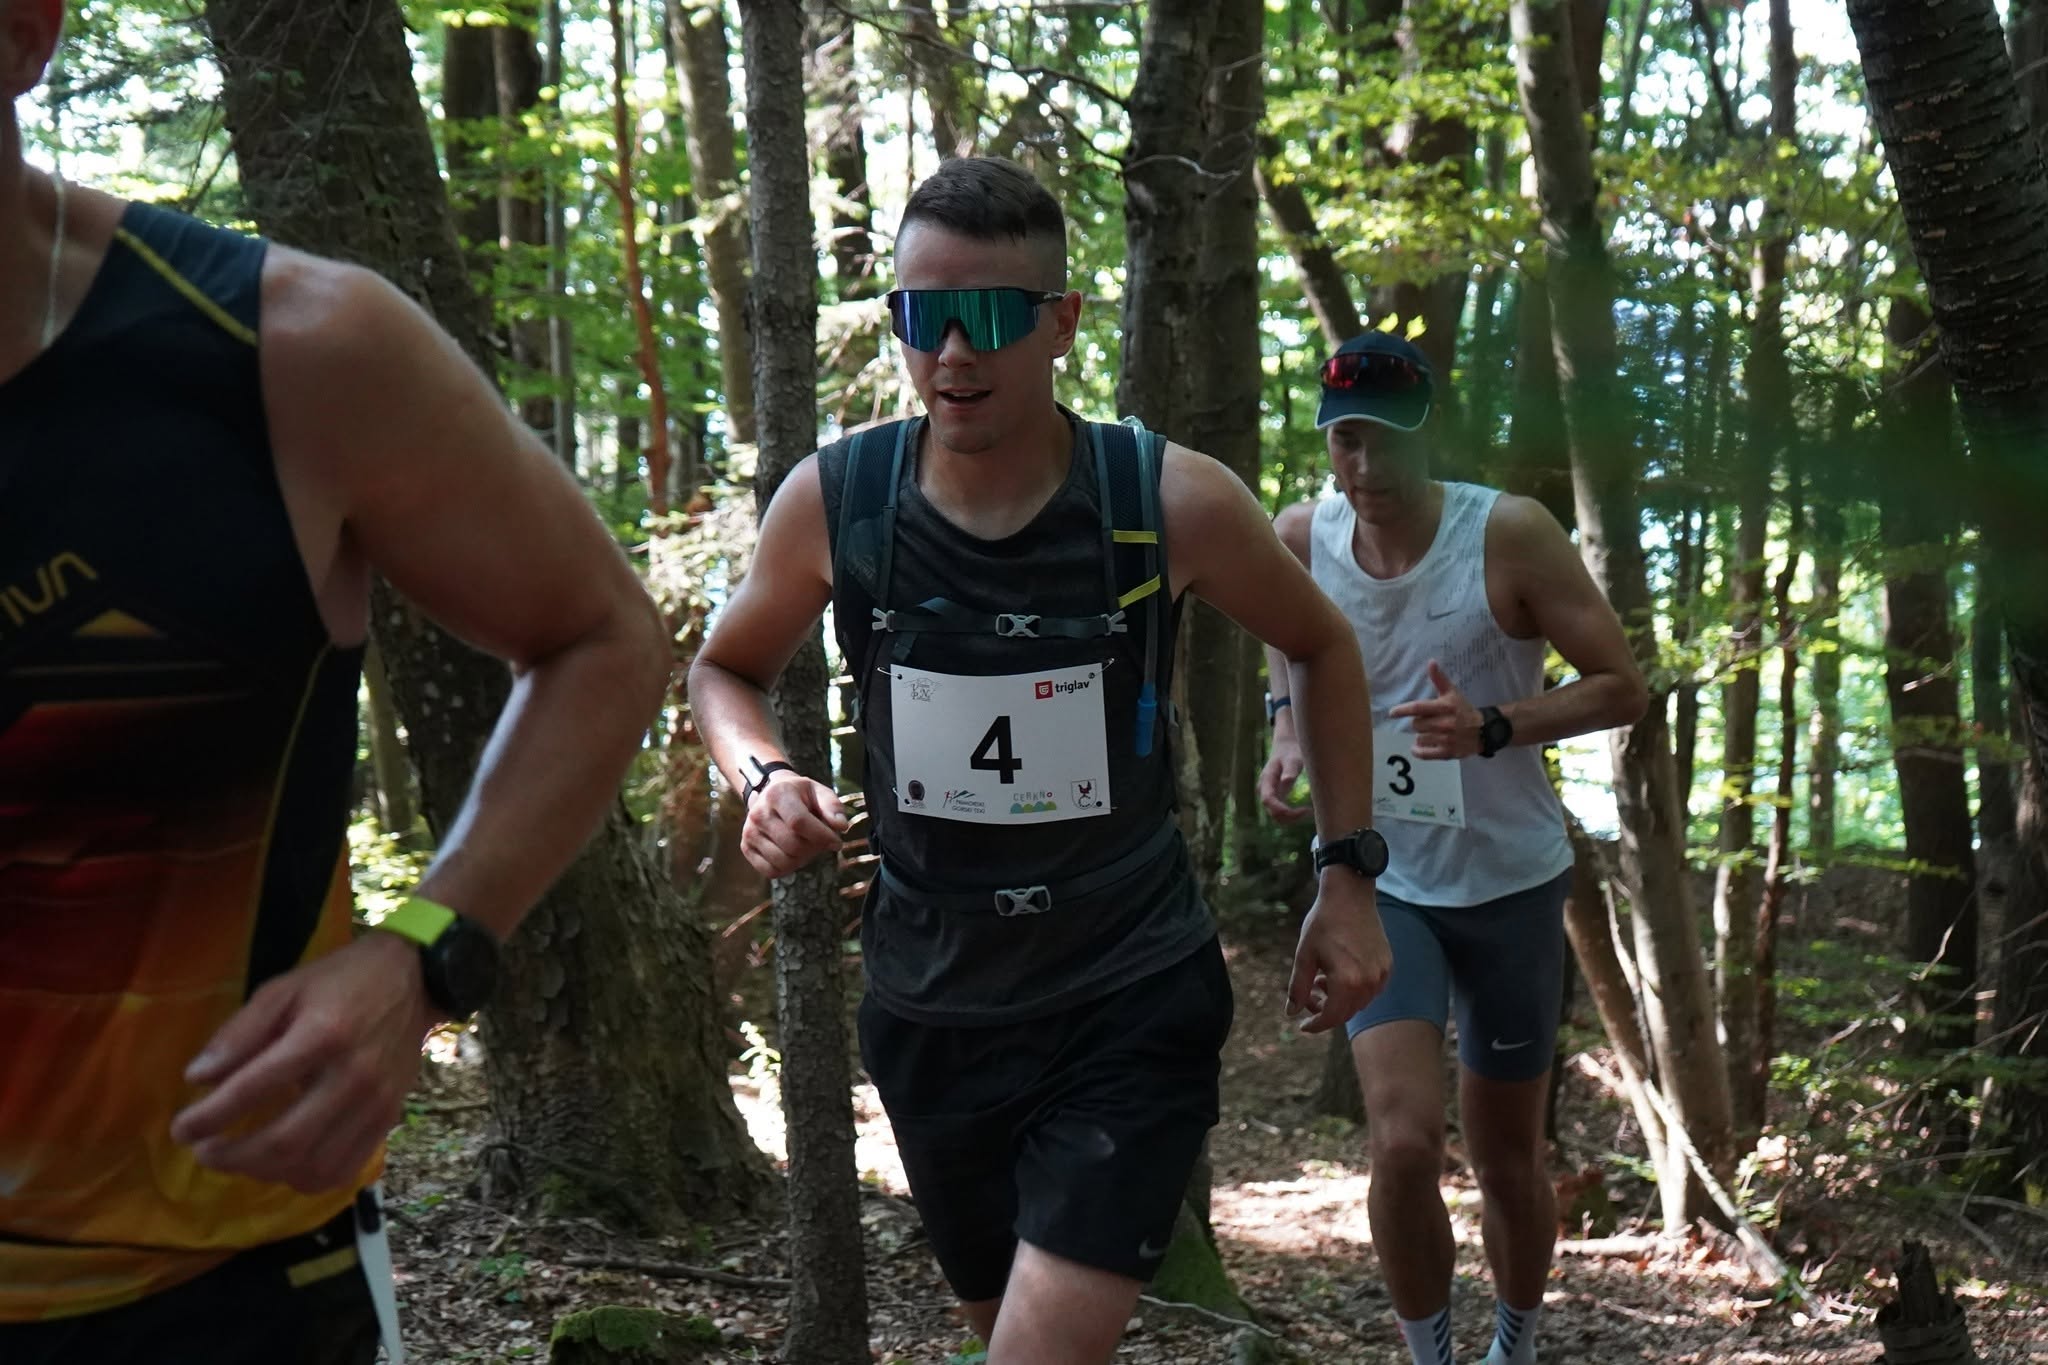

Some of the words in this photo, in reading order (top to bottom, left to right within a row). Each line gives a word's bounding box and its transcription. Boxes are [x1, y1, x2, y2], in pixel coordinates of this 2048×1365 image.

[1055, 680, 1089, 694] triglav
[970, 715, 1023, 785] 4
[1386, 754, 1415, 796] 3
[1013, 789, 1053, 802] CERKNO
